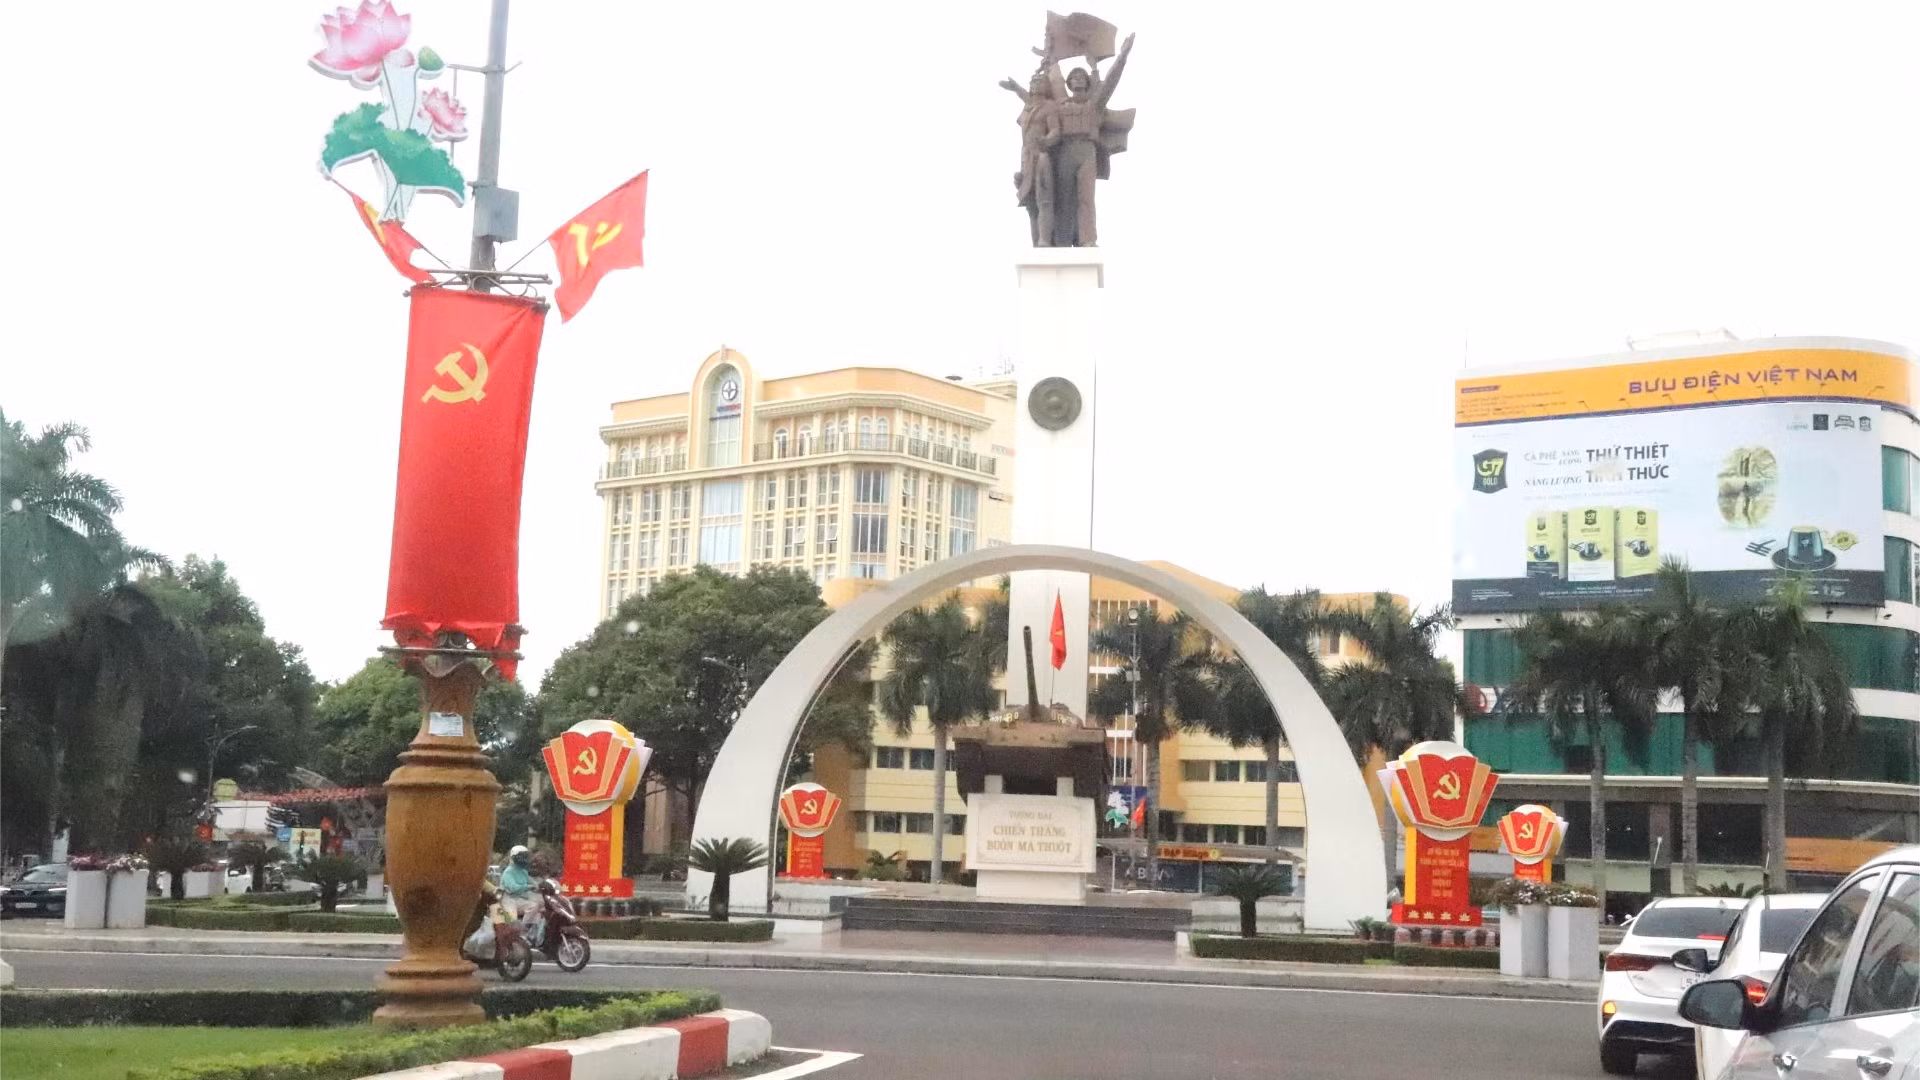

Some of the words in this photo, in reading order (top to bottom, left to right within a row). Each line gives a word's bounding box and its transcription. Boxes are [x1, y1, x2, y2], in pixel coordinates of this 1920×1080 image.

[1628, 377, 1676, 394] BƯU
[1683, 370, 1741, 391] ĐIỆN
[1747, 365, 1800, 385] VIỆT
[1806, 367, 1858, 382] NAM
[1623, 441, 1669, 462] THIỆT
[1627, 463, 1669, 481] THỨC
[1018, 841, 1034, 852] MA
